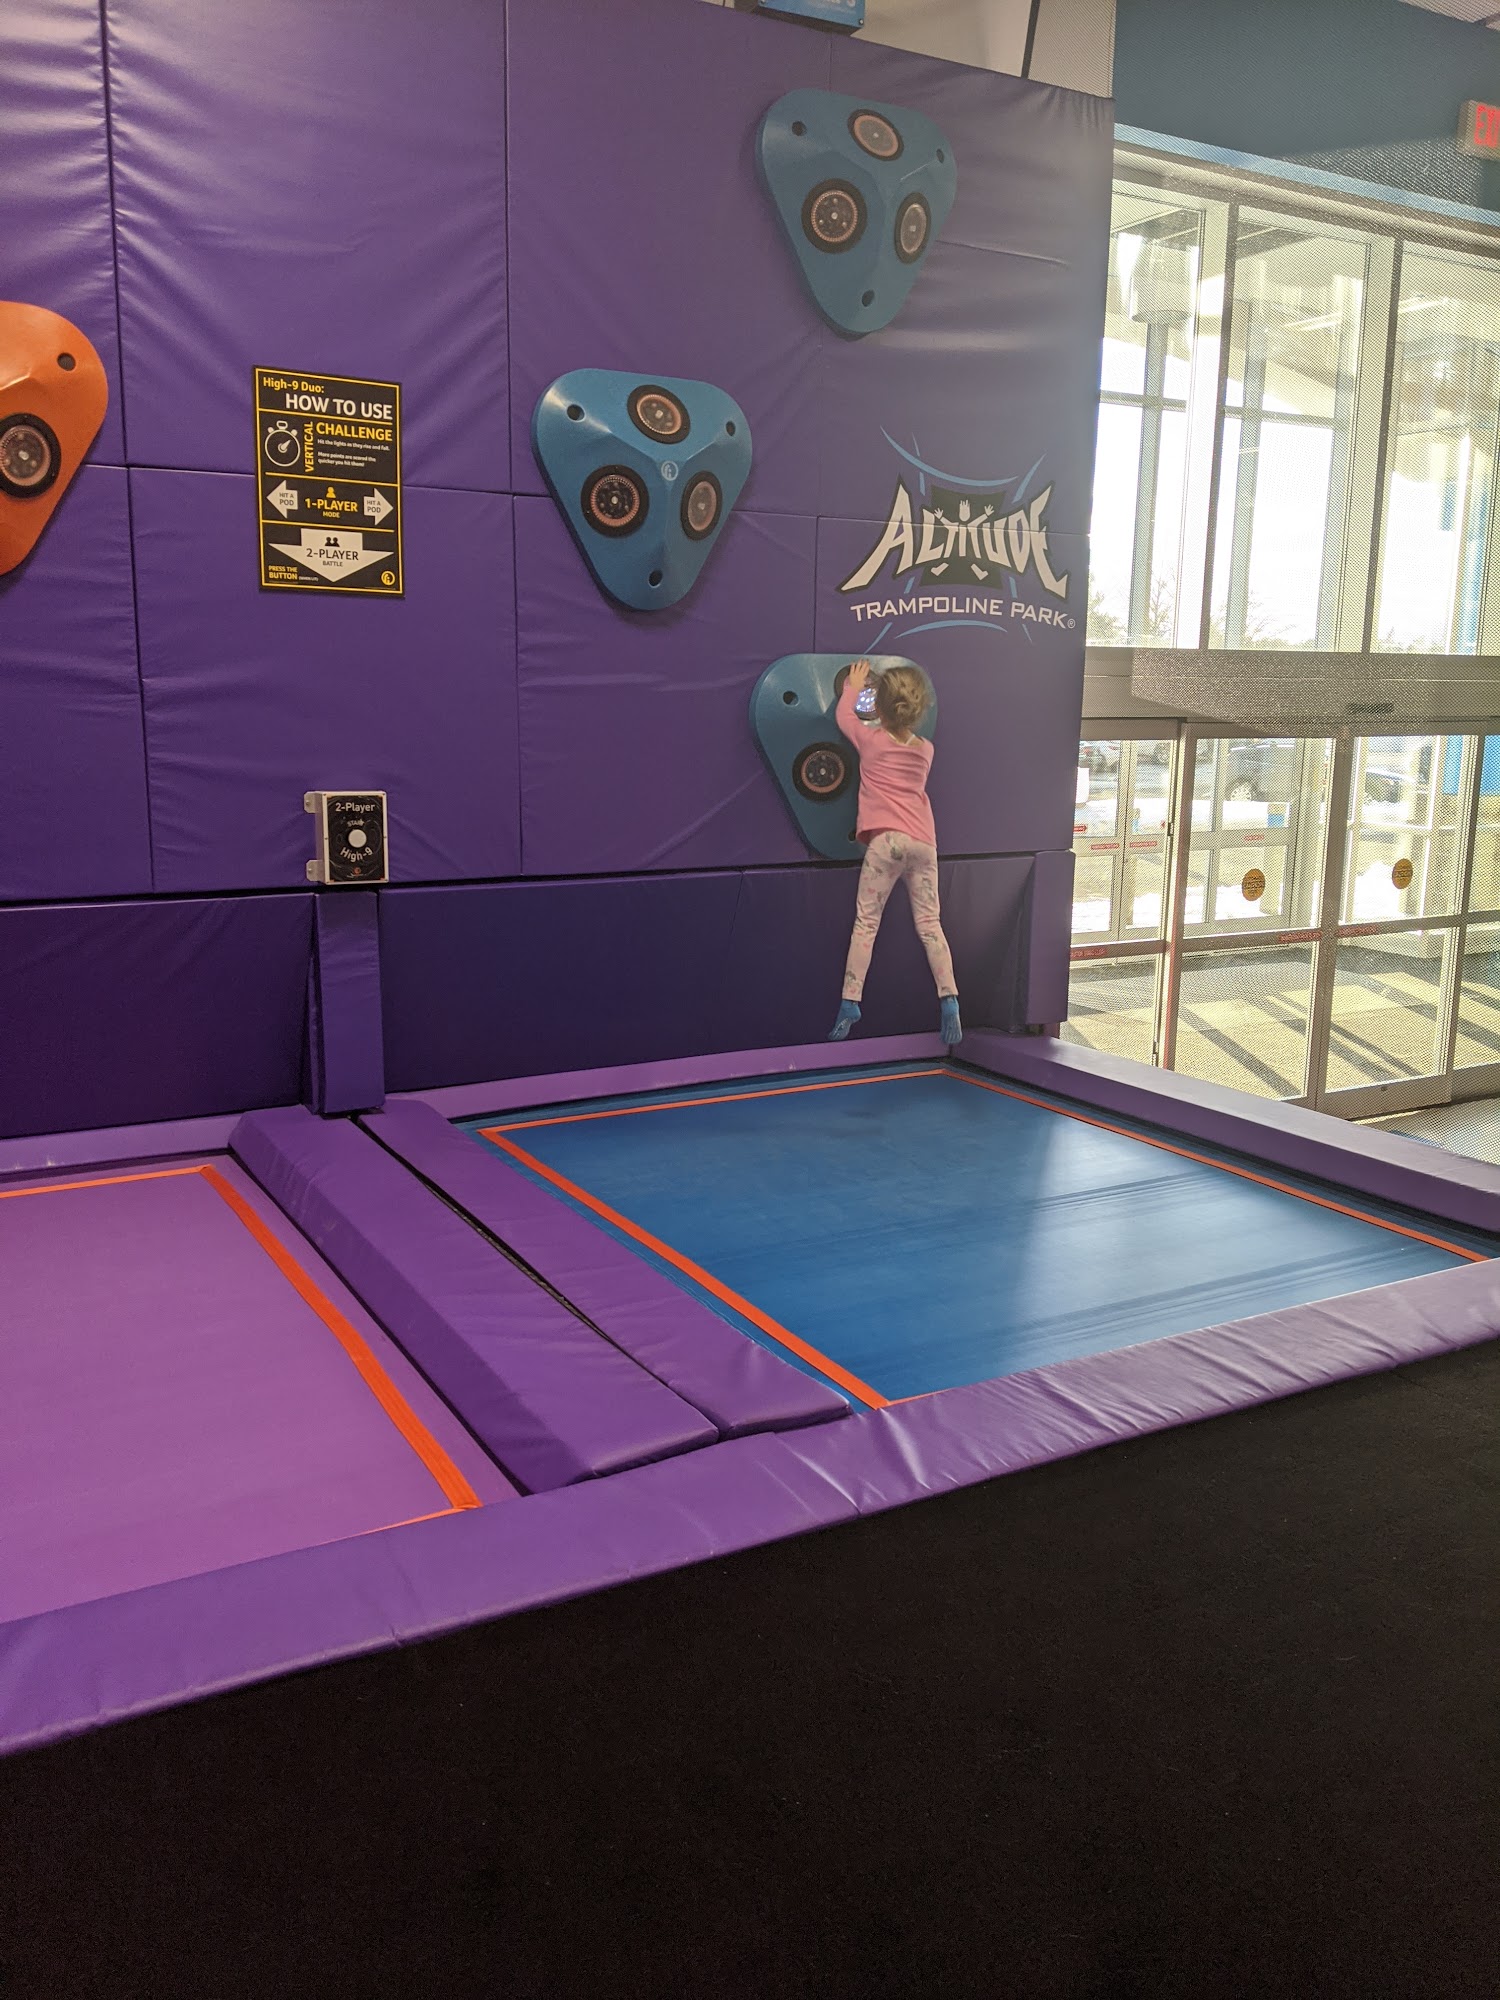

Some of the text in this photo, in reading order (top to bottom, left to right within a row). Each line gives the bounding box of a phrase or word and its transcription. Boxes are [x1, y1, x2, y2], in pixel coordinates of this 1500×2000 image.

[263, 377, 324, 393] High-9 Duo:
[285, 393, 393, 420] HOW TO USE
[316, 422, 393, 441] CHALLENGE
[304, 421, 314, 472] VERTICAL
[305, 498, 358, 512] 1-PLAYER
[841, 484, 1068, 599] ALTITUDE
[306, 548, 359, 561] 2-PLAYER
[269, 572, 298, 580] BUTTON
[850, 596, 1003, 622] TRAMPOLINE
[335, 802, 375, 813] 2-Player
[340, 846, 373, 862] High-9
